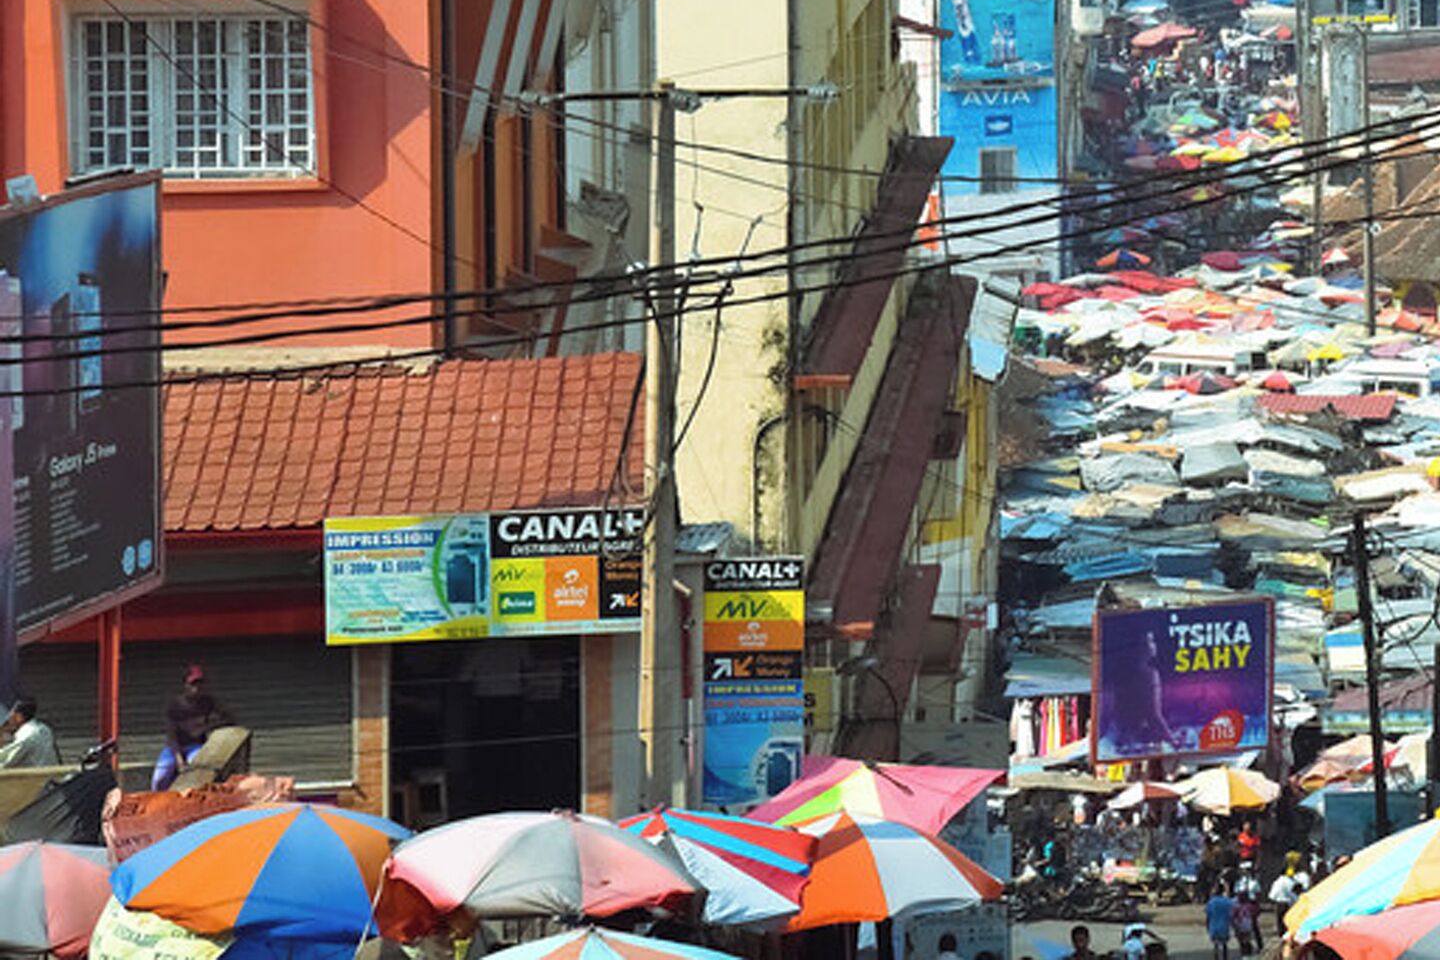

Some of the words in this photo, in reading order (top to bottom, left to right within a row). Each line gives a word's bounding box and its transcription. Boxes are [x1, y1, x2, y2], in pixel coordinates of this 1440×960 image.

[961, 91, 1031, 107] AVIA
[50, 455, 83, 478] Galaxy
[497, 511, 643, 543] CANAL+
[327, 531, 434, 548] IMPRESSION
[510, 542, 599, 556] DISTRIBUTEUR
[707, 562, 800, 579] CANAL+
[1174, 644, 1251, 672] SAHY
